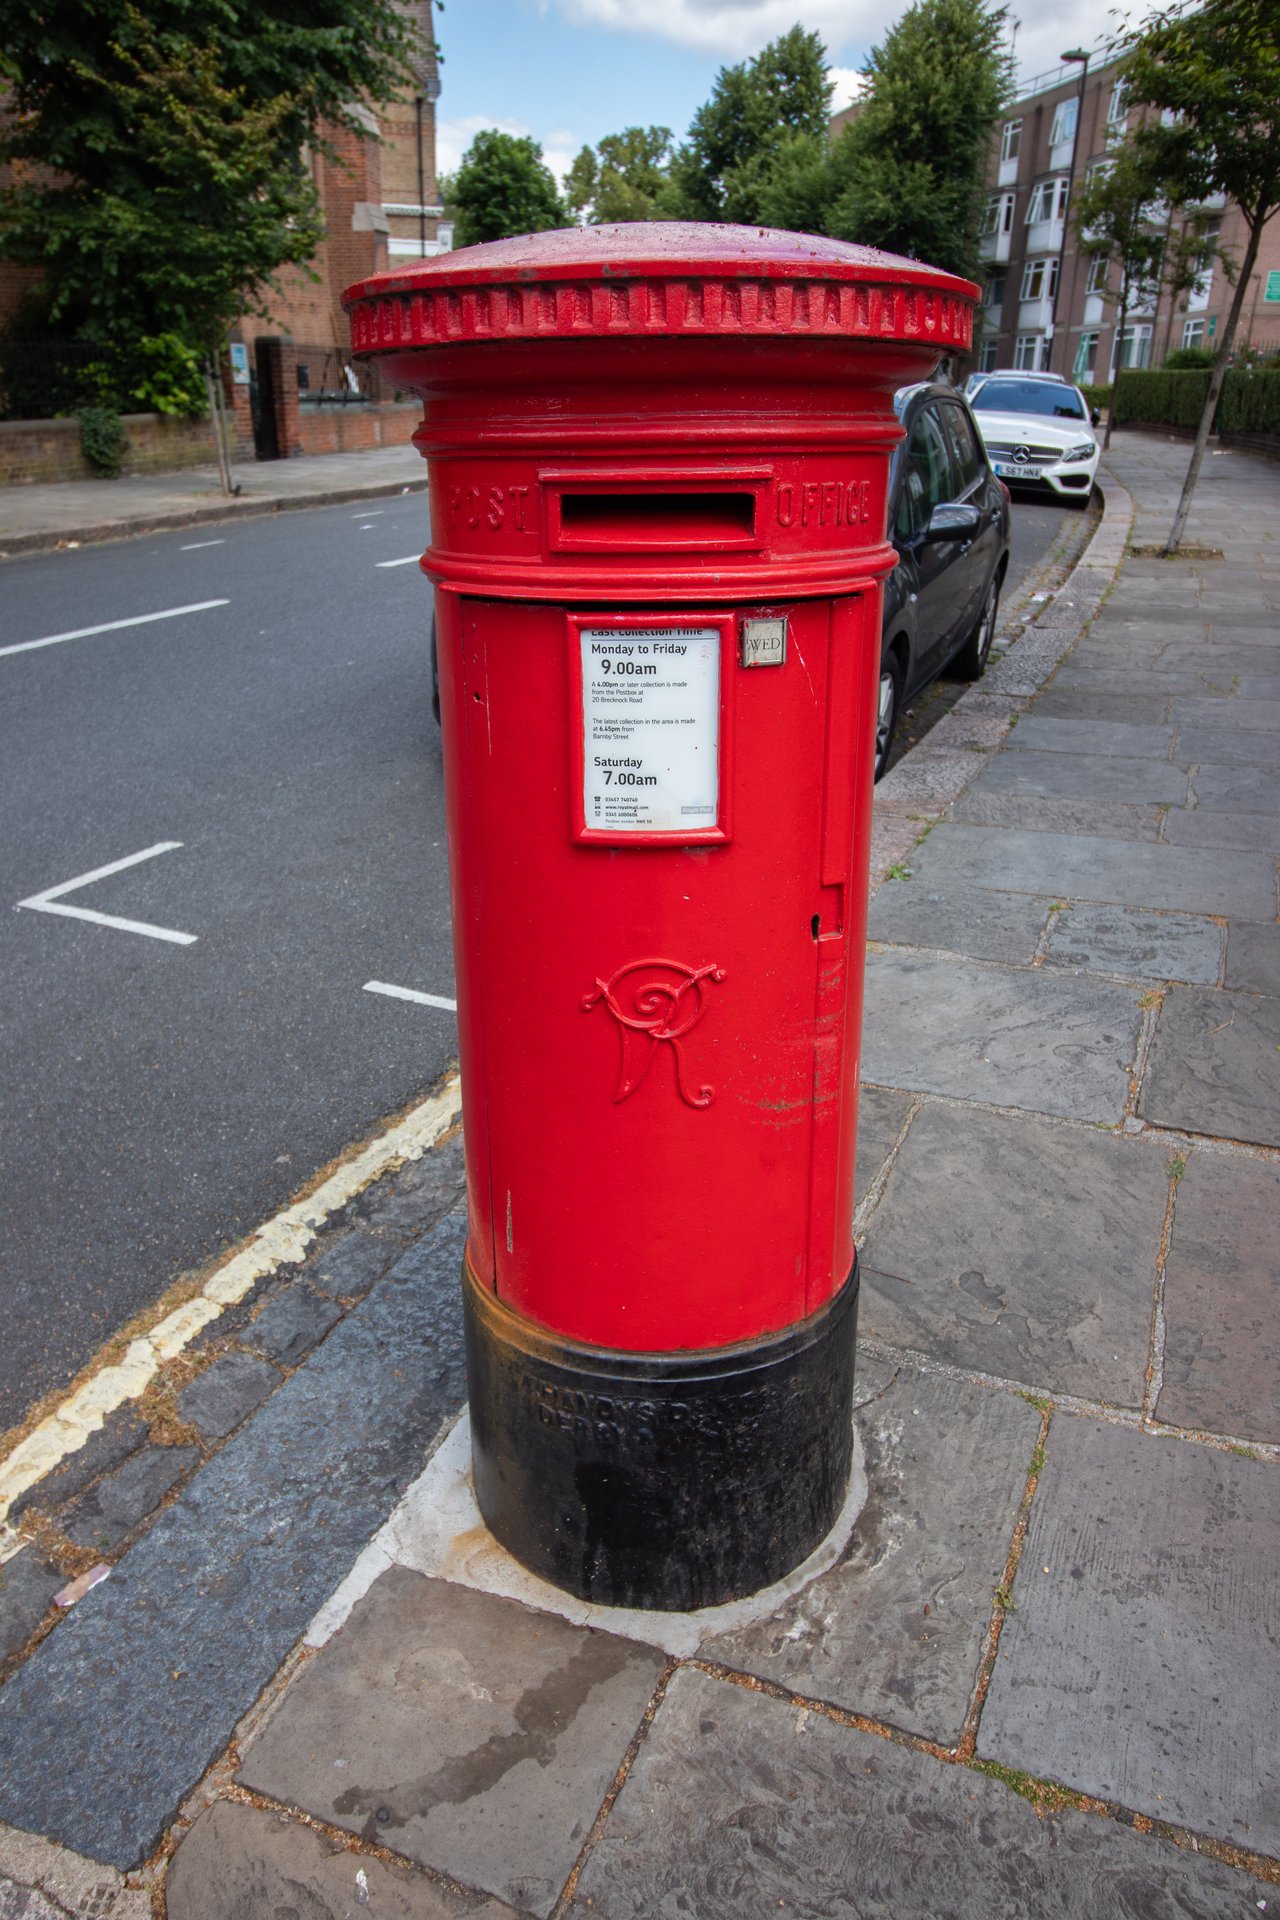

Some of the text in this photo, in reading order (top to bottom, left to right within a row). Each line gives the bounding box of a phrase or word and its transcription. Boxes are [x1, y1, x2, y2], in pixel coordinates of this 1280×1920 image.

[450, 480, 870, 530] POST OFFICE
[591, 643, 687, 656] Monday to Friday
[749, 637, 780, 651] WED
[601, 659, 657, 675] 9.00am
[597, 681, 618, 689] 4.00pm
[592, 717, 603, 725] The
[594, 756, 643, 769] Saturday
[603, 770, 657, 786] 7.00am
